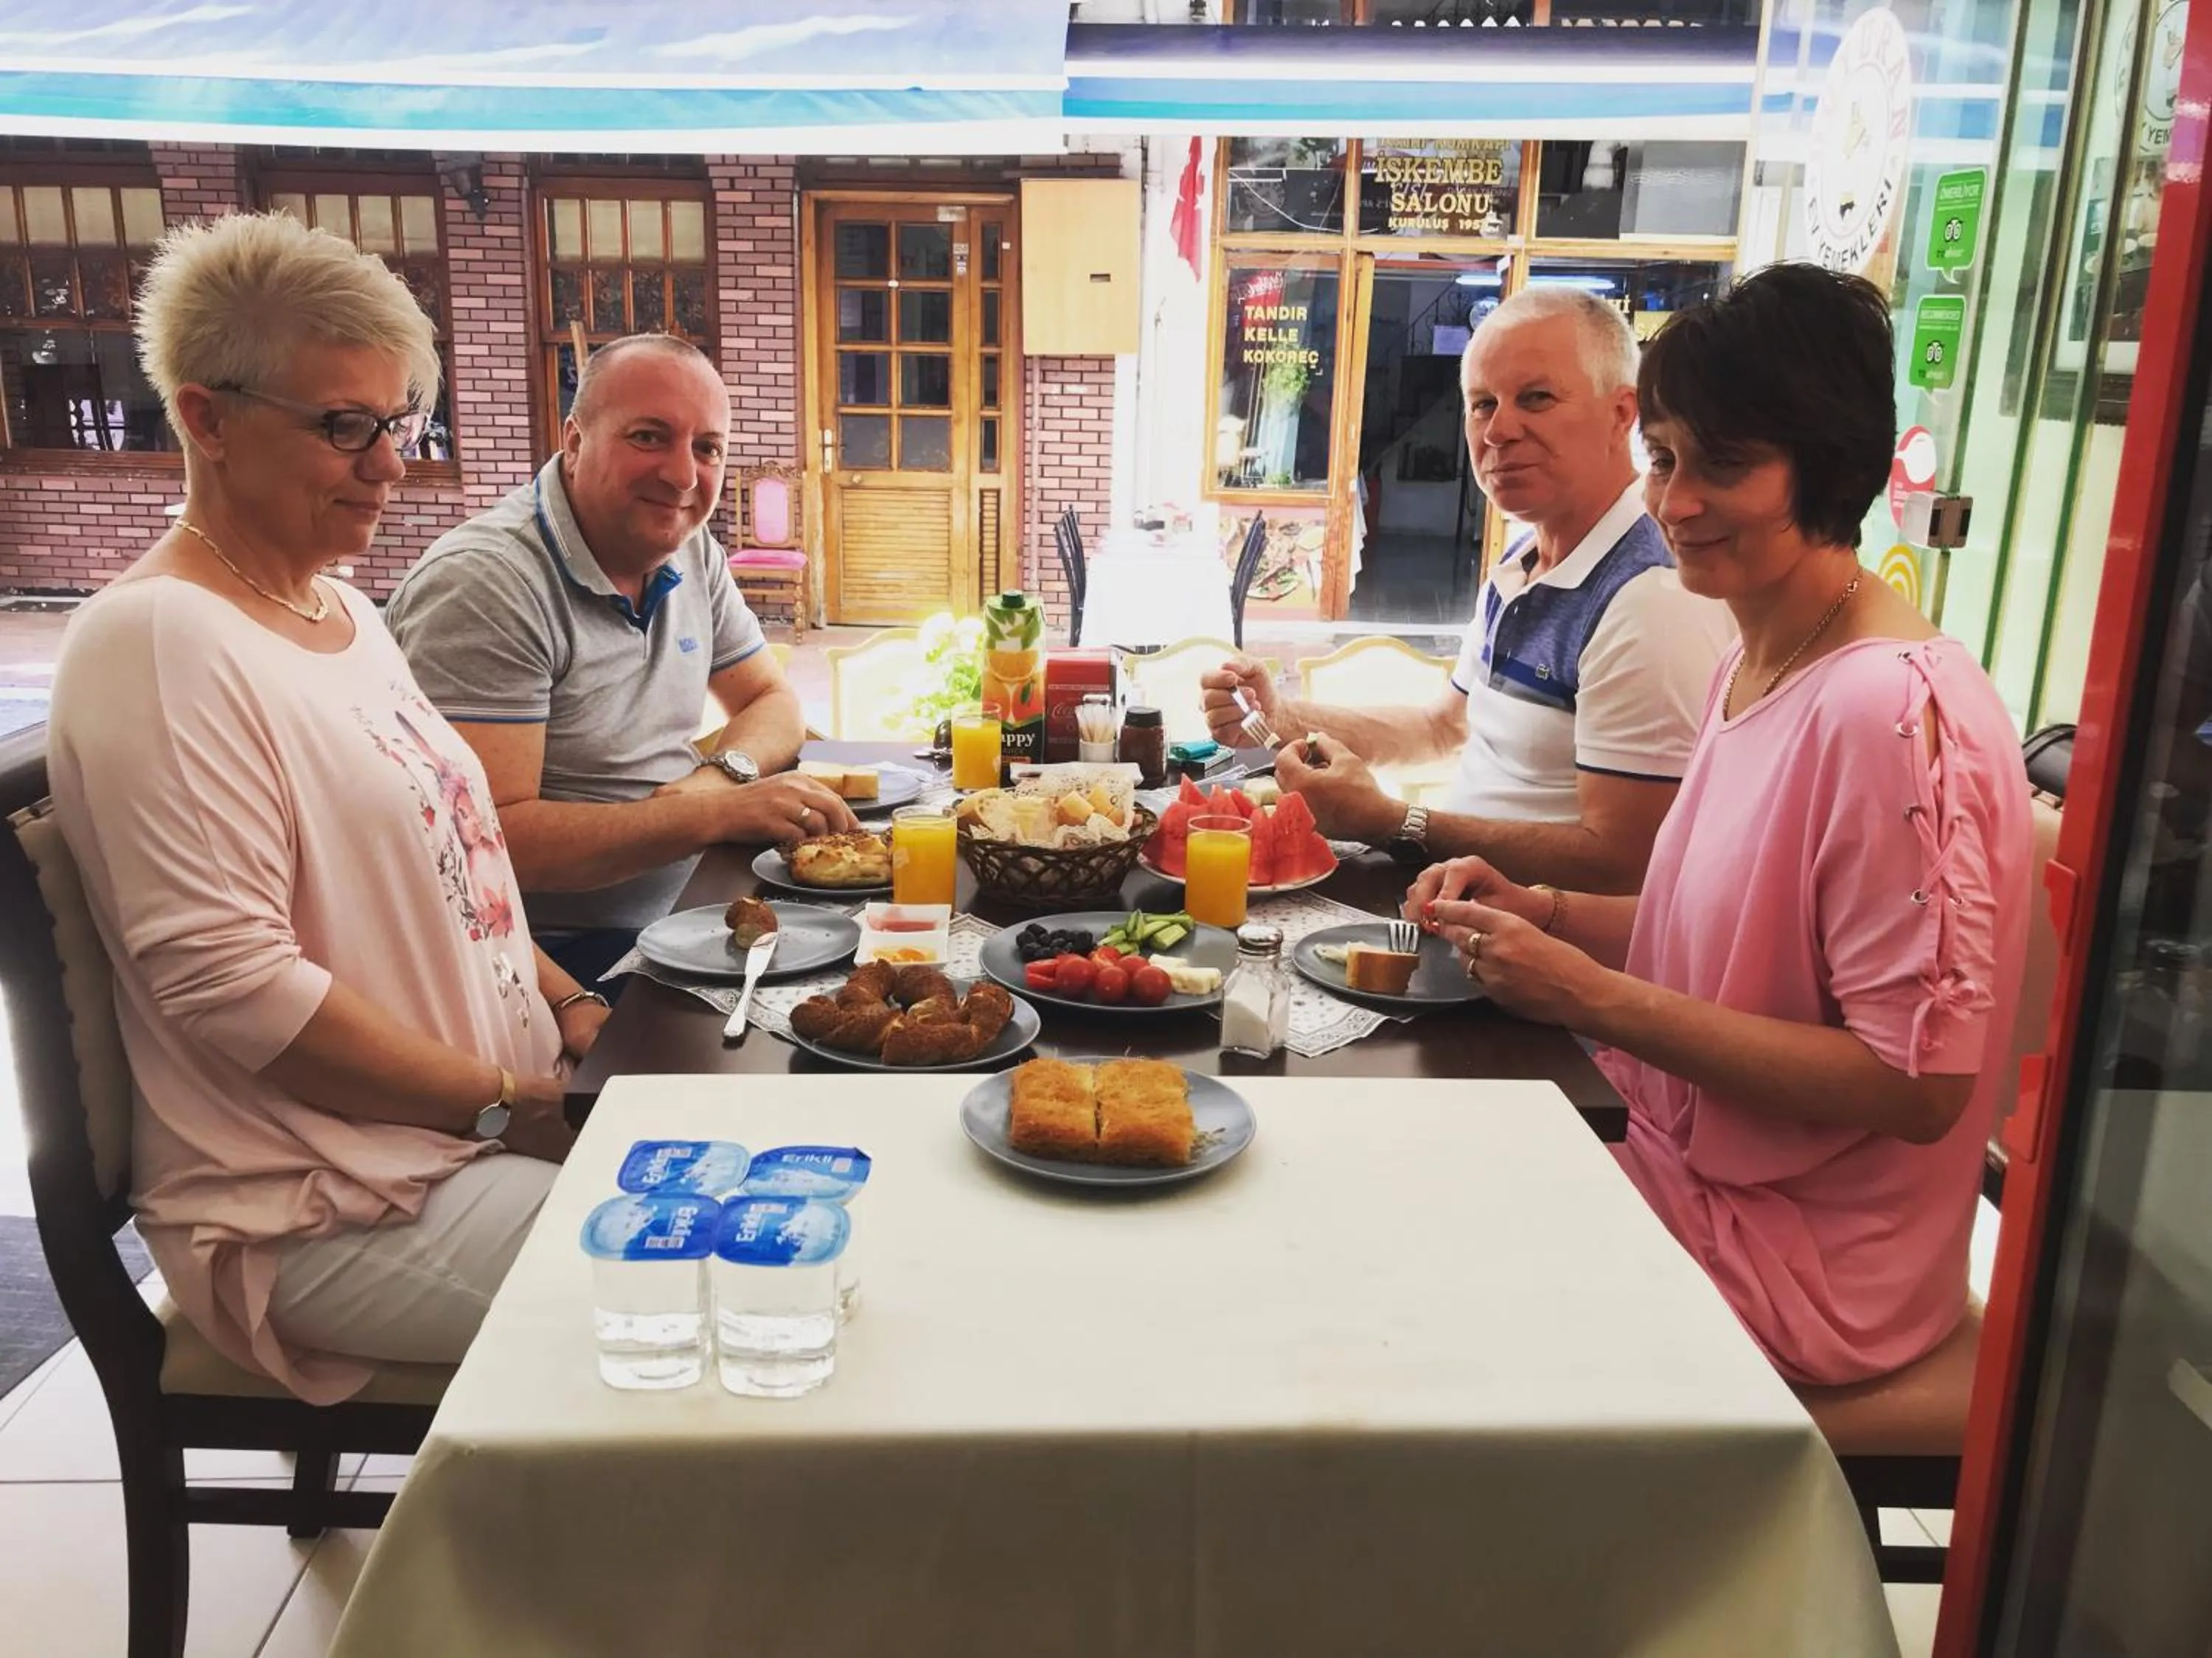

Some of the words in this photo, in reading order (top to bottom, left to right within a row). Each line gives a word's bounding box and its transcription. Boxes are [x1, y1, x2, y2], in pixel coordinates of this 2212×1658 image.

[1391, 192, 1489, 215] SALONU
[1388, 217, 1449, 232] KURULUŞ
[1244, 306, 1307, 321] TANDIR
[1244, 327, 1298, 342] KELLE
[1242, 350, 1319, 369] KOKOREÇ
[1001, 732, 1035, 747] appy
[782, 1154, 834, 1164] Erikli
